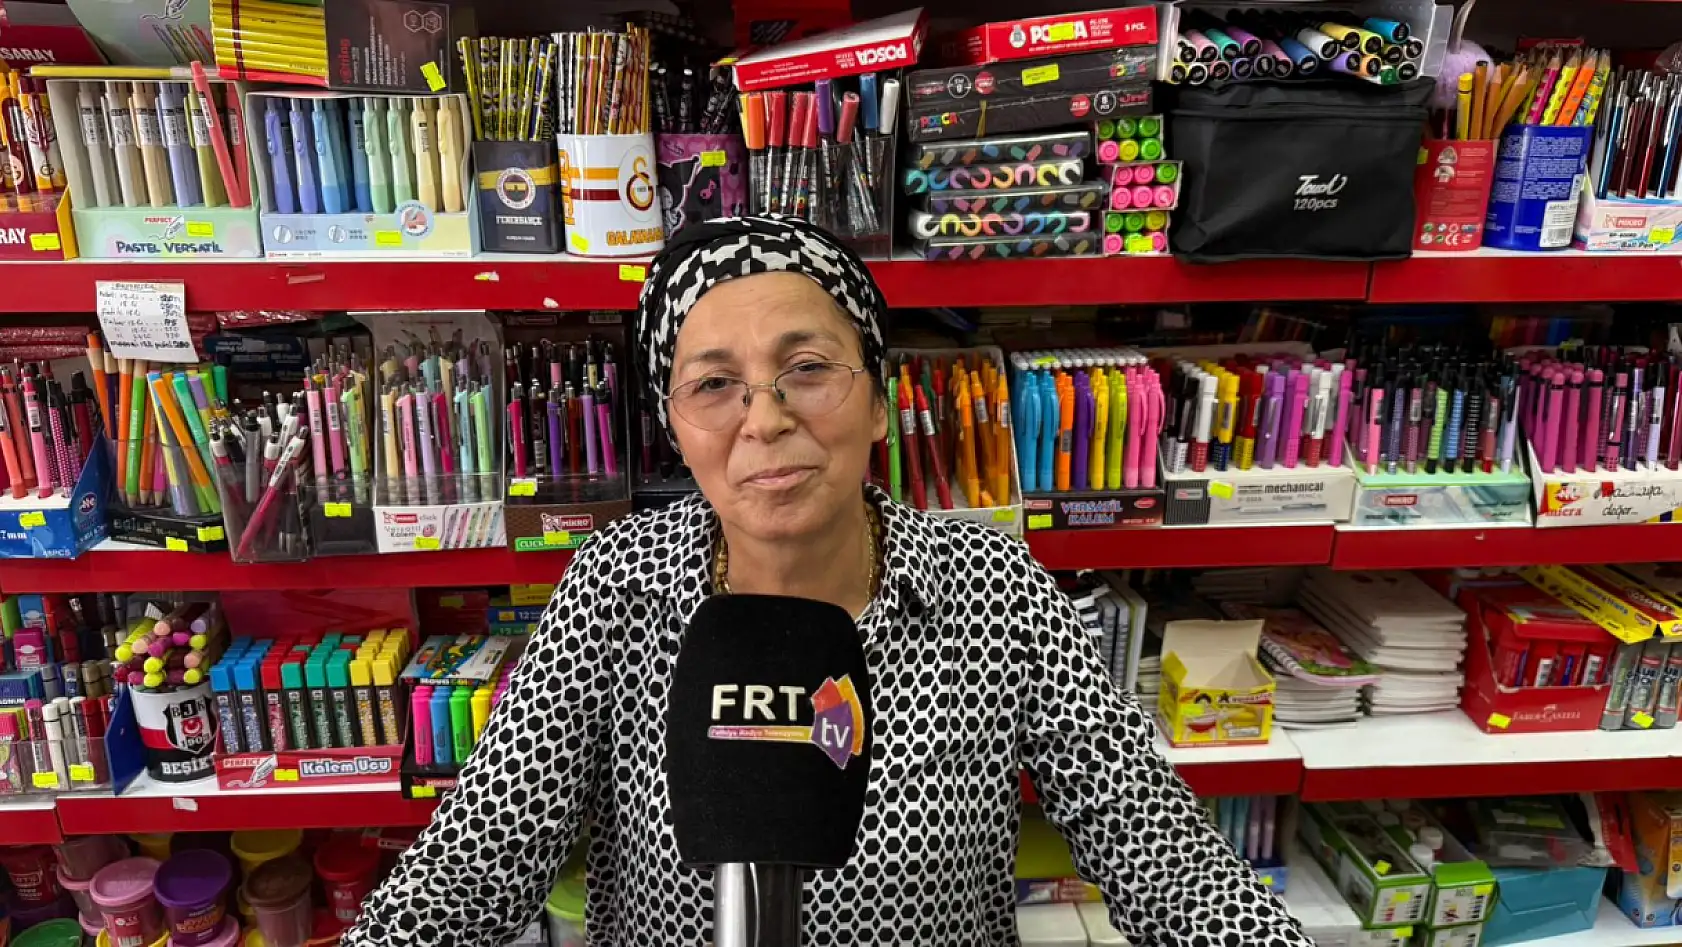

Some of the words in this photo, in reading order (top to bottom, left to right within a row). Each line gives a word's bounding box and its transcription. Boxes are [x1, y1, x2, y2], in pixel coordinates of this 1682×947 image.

[1030, 21, 1088, 45] POA
[856, 43, 907, 66] POSCA
[1293, 198, 1338, 212] 120pcs
[115, 241, 161, 254] PASTEL
[1264, 482, 1324, 494] mechanical
[711, 684, 806, 721] FRT
[821, 717, 850, 748] tv
[302, 762, 354, 775] Kalem
[358, 759, 390, 772] Ucu
